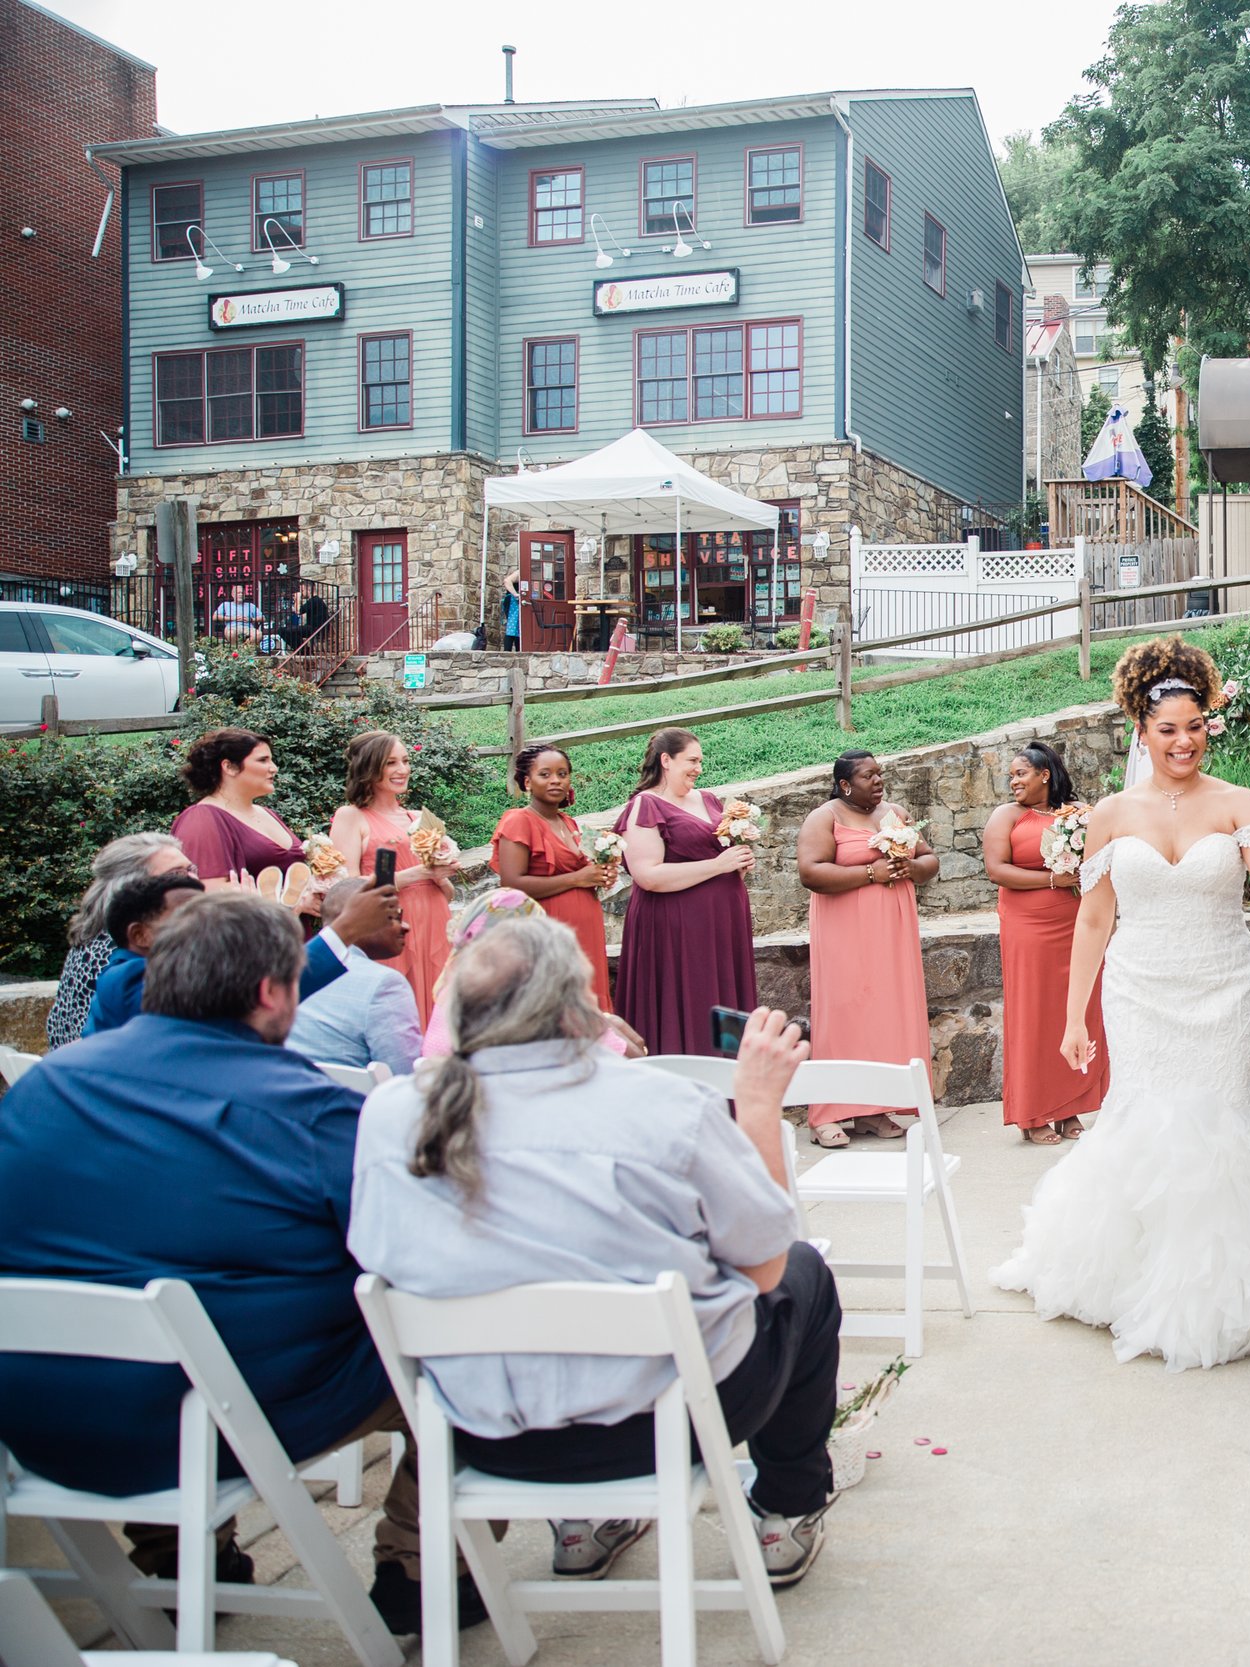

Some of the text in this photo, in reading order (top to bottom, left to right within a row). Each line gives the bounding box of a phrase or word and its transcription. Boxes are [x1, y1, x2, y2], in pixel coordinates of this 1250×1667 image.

[625, 278, 730, 300] Matcha Time Cafe
[238, 293, 336, 315] Matcha Time Cafe
[699, 531, 742, 546] TEA
[757, 546, 797, 561] ICE
[216, 564, 273, 578] SHOP
[198, 584, 253, 598] SAE
